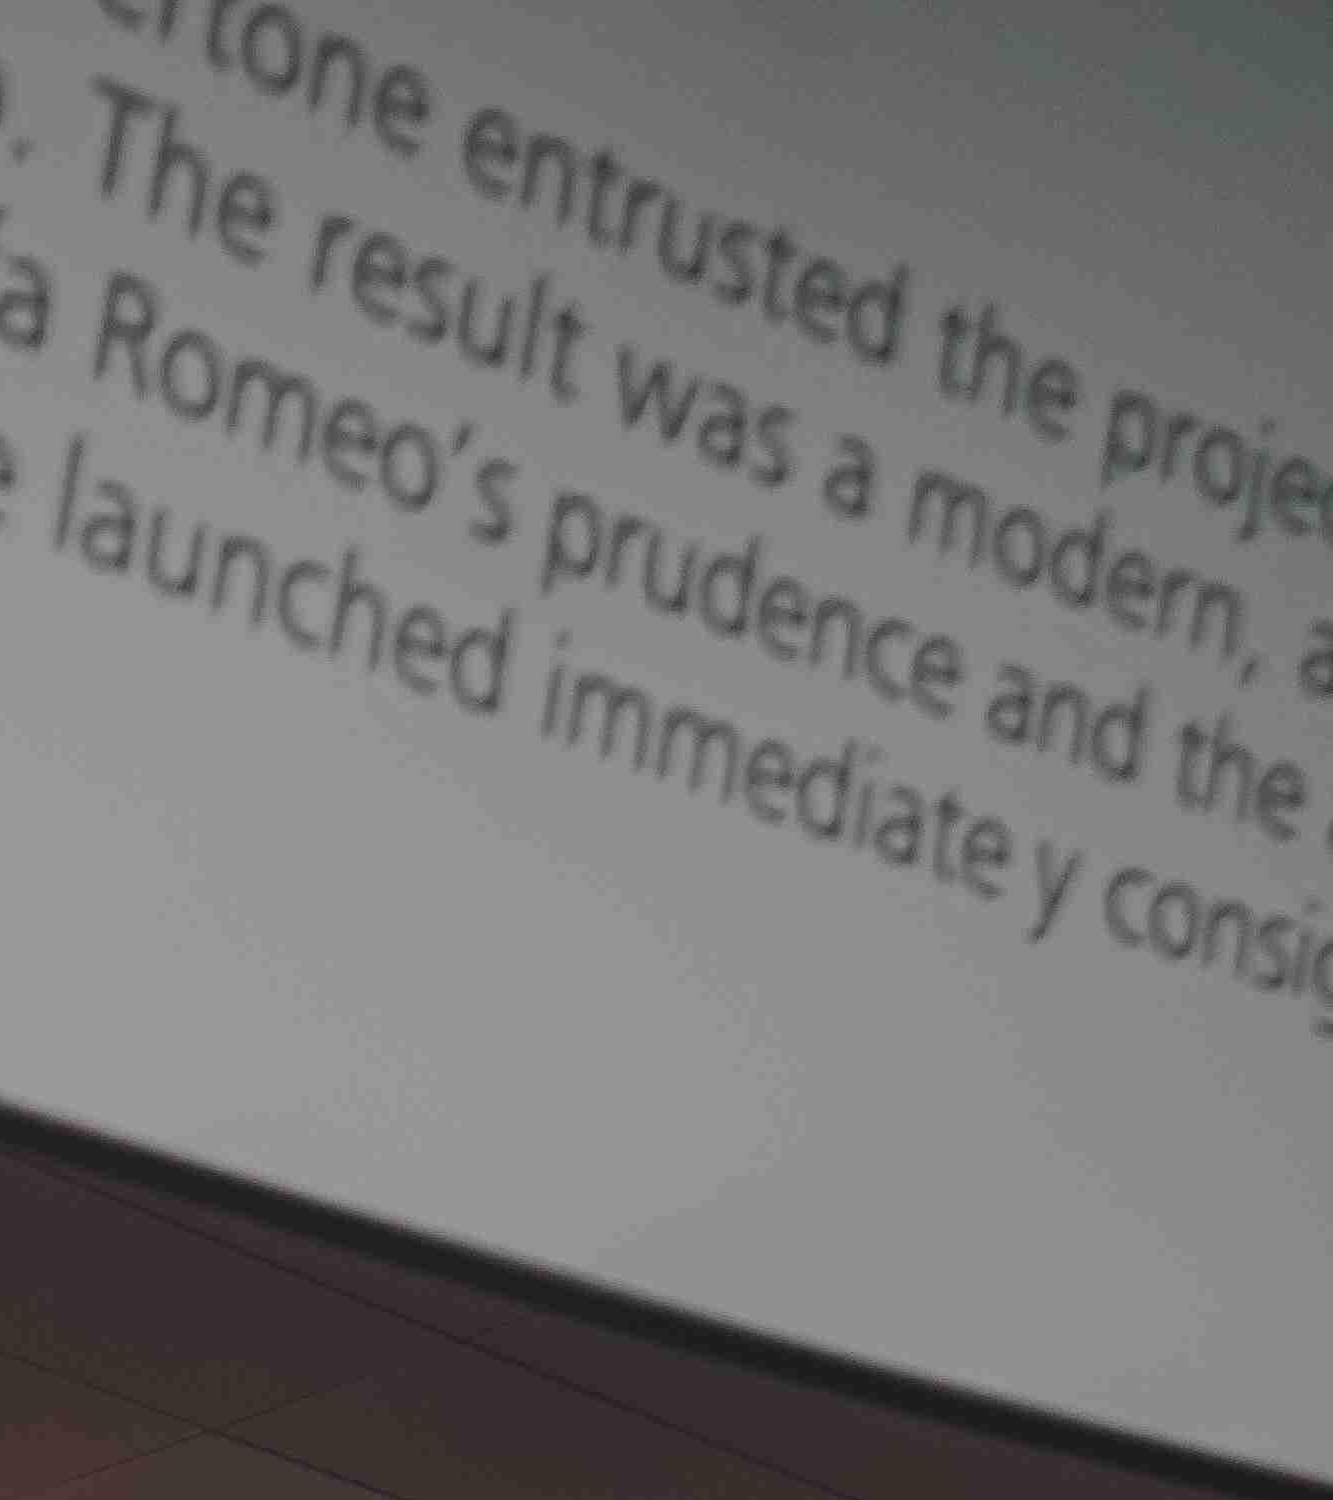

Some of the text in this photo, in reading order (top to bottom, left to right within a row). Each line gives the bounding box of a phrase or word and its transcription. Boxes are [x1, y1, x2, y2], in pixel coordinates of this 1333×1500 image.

[52, 433, 518, 718] launched
[91, 75, 279, 267] The
[309, 213, 587, 405] result
[616, 345, 796, 490] was
[821, 434, 878, 521] a
[906, 469, 1260, 685] modern,
[92, 269, 518, 547] Romeo's
[539, 490, 966, 720] prudence
[984, 663, 1151, 784] and
[1176, 715, 1310, 843] the
[462, 107, 910, 367] entrusted
[939, 303, 1078, 441] the
[1101, 390, 1333, 547] proje
